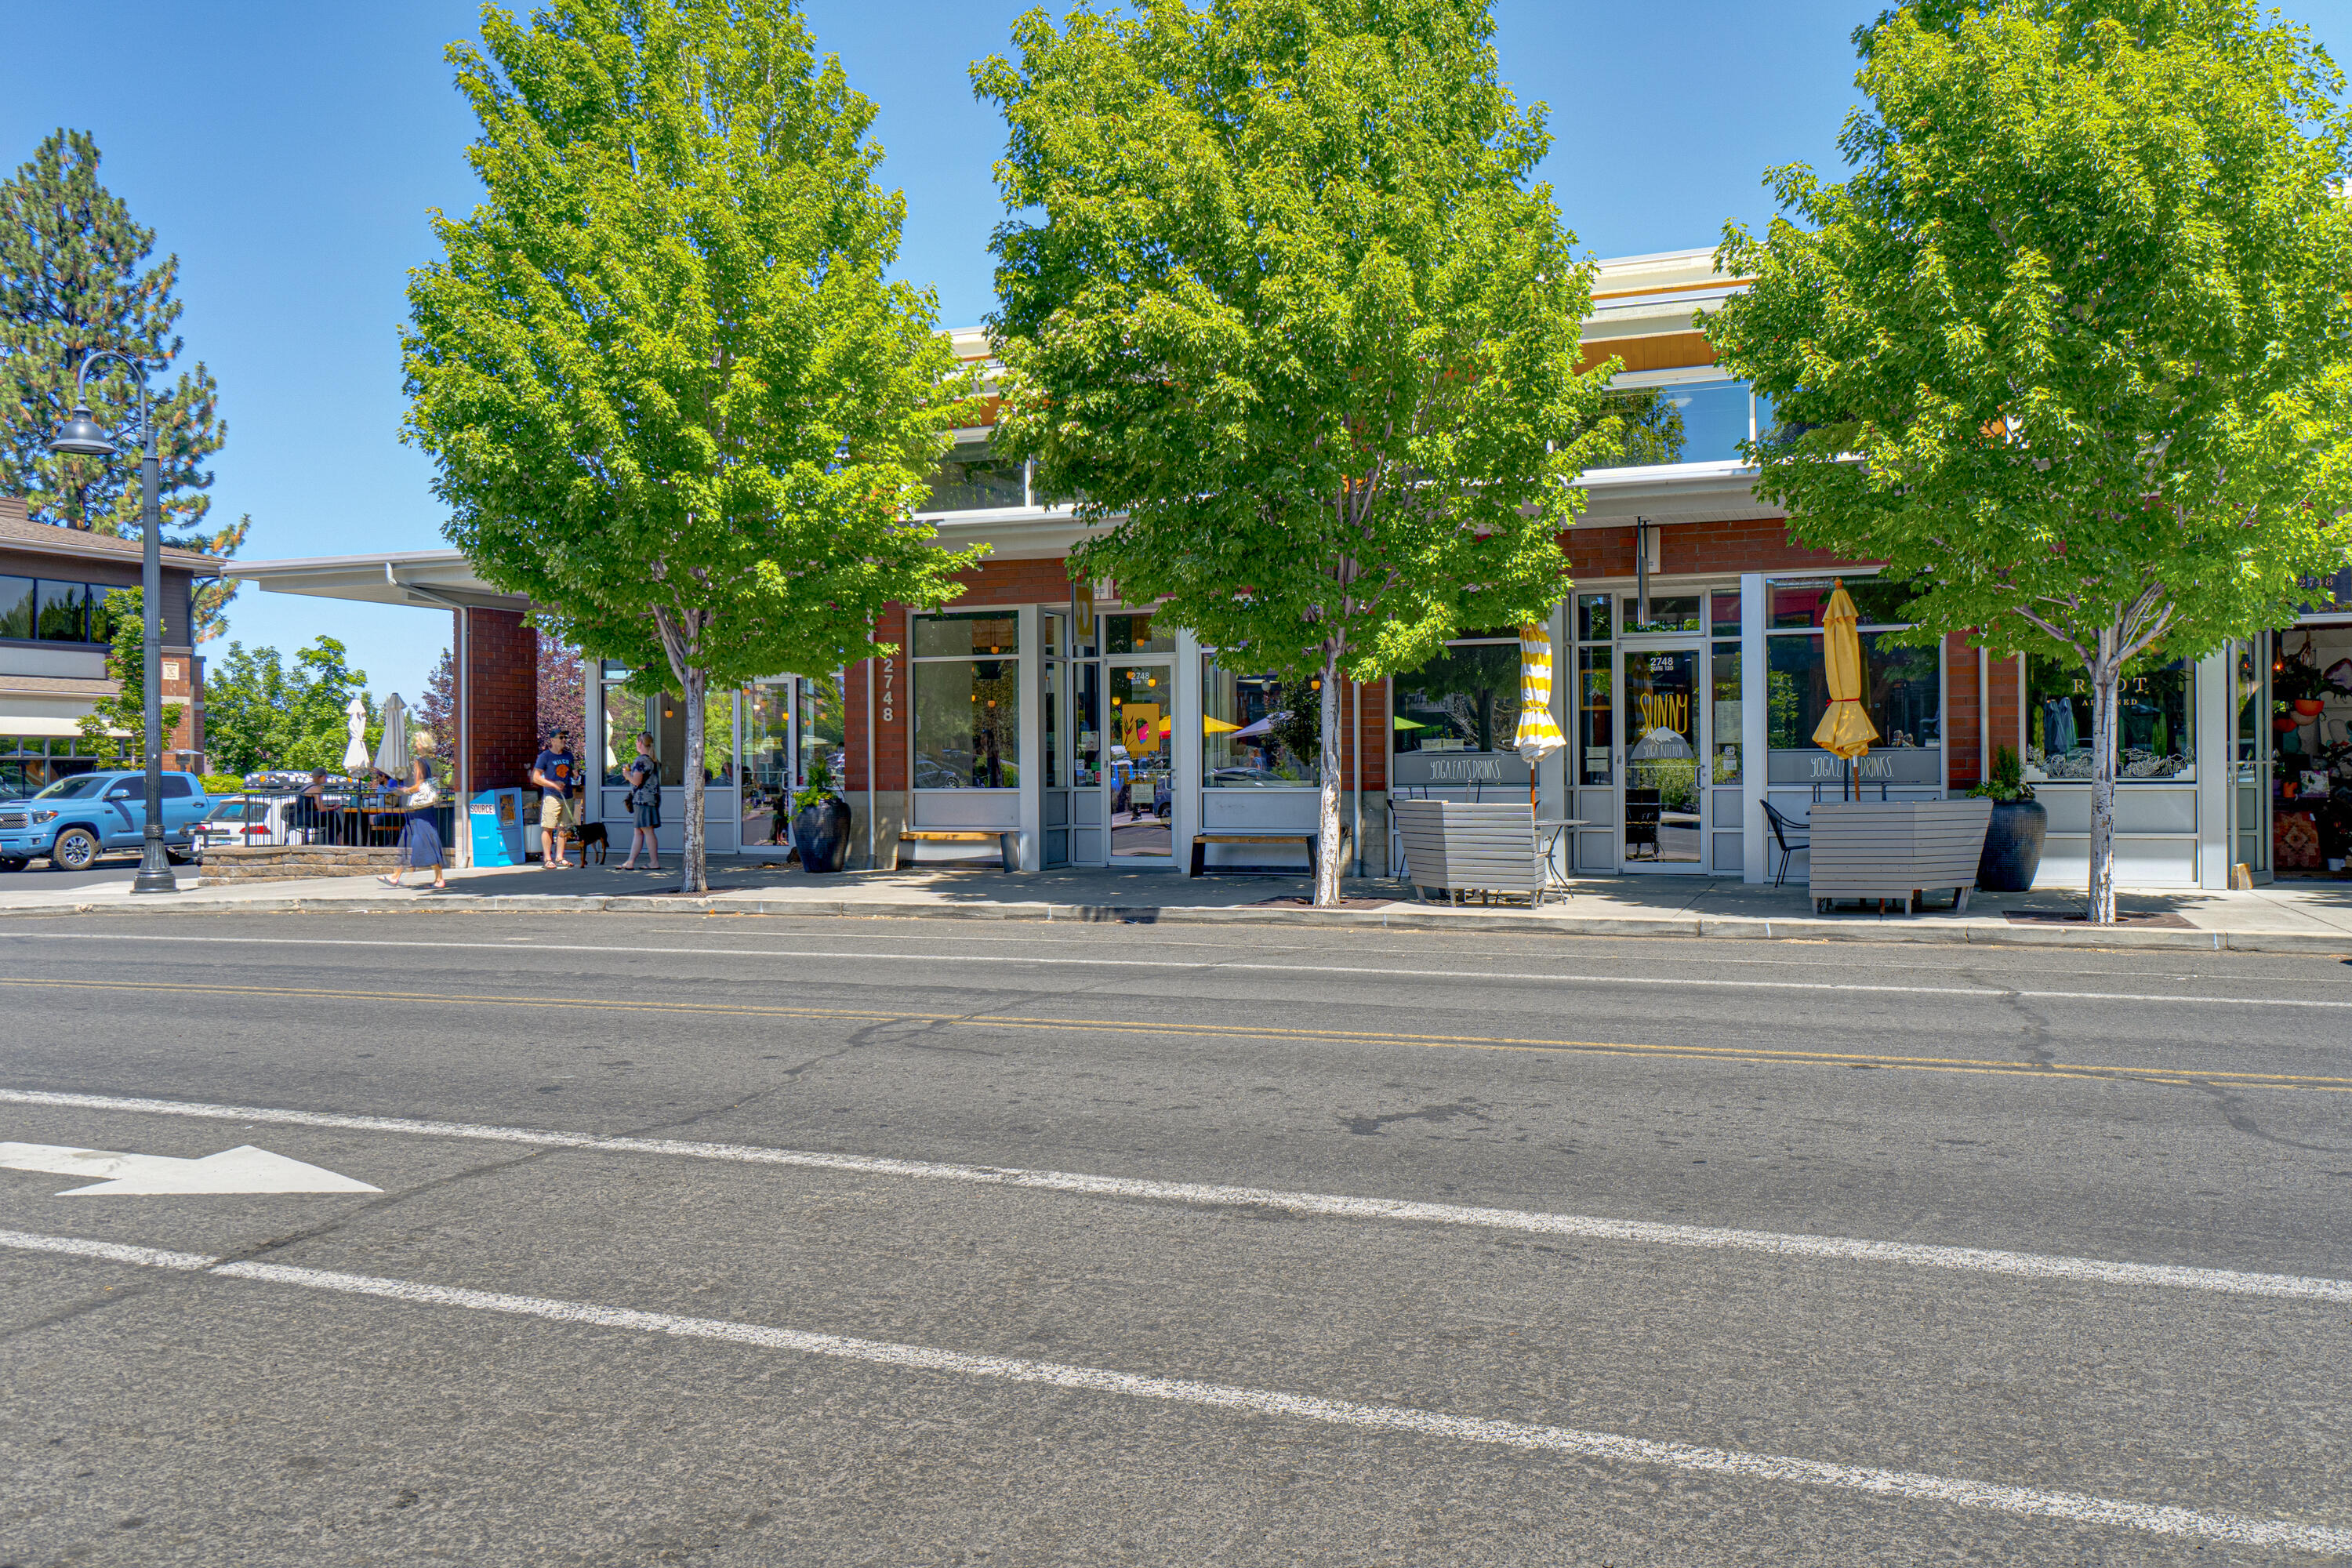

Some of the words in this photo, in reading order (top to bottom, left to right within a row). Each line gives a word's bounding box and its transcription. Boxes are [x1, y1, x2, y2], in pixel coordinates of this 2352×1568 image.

[2299, 577, 2333, 588] 2748
[1650, 657, 1674, 666] 2748
[1131, 672, 1149, 681] 2748
[883, 659, 893, 721] 2748
[2071, 677, 2148, 693] ROT
[1639, 692, 1688, 735] SUNNY
[1643, 744, 1658, 757] YOGA
[1661, 744, 1683, 757] KITCHEN
[470, 804, 492, 814] SOURCE
